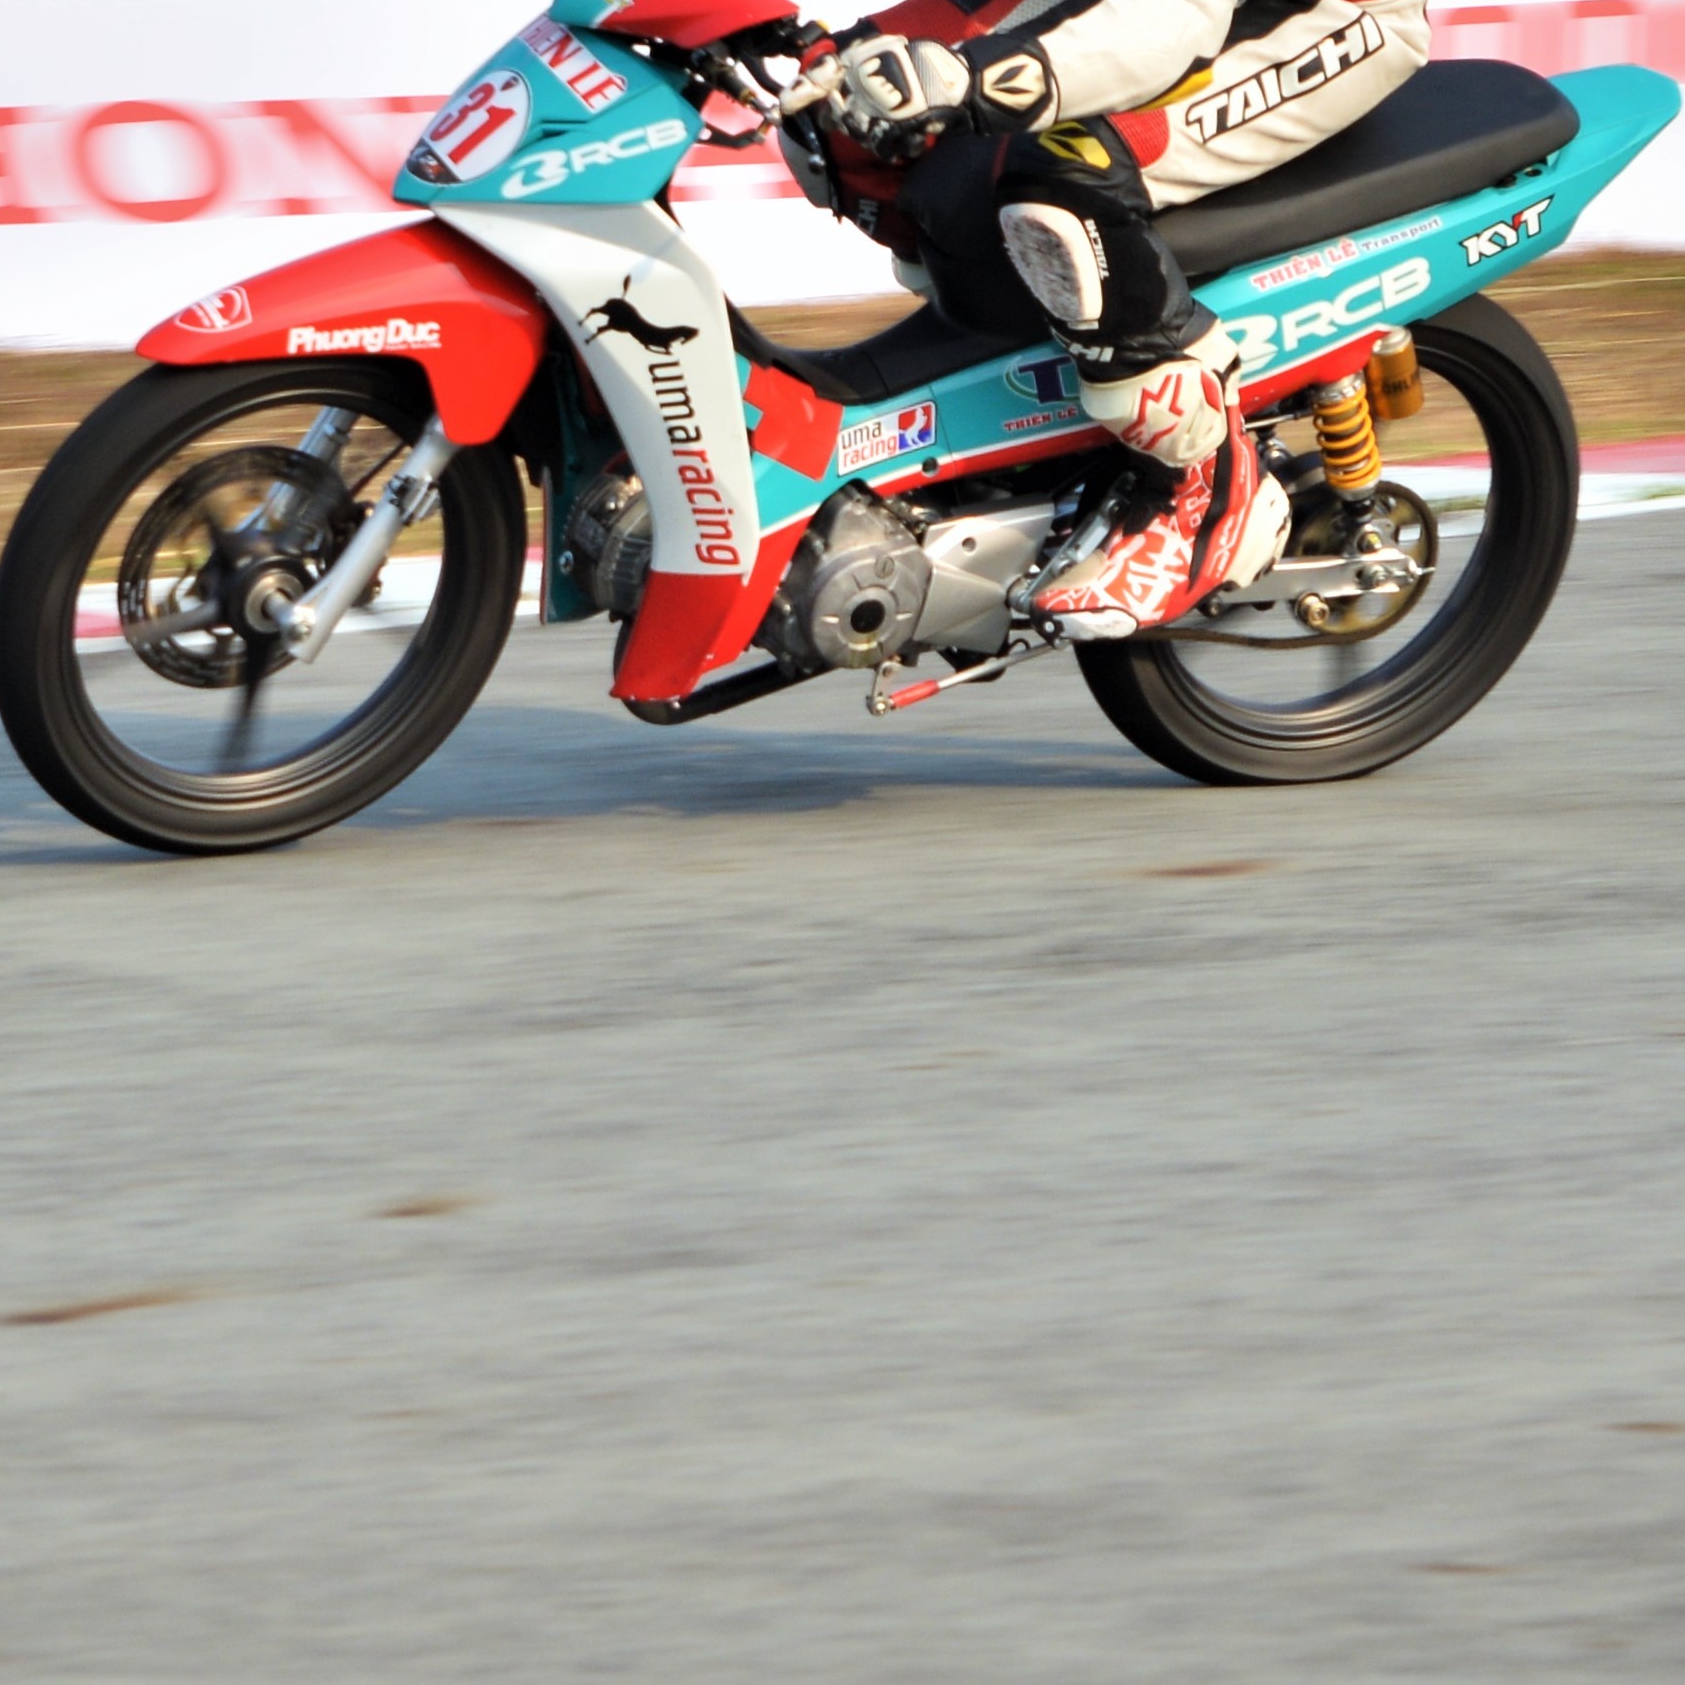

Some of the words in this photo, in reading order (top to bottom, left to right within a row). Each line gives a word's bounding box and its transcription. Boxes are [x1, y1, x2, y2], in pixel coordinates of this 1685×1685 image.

[1185, 11, 1385, 144] TAICHI
[428, 81, 518, 166] 31
[568, 119, 688, 173] RCB
[1252, 255, 1322, 290] THIÊN
[1326, 235, 1357, 264] LÊ
[1361, 218, 1441, 252] Transport
[1458, 194, 1555, 267] KYT
[1281, 257, 1432, 352] RCB
[841, 421, 883, 451] uma
[842, 433, 898, 469] racing
